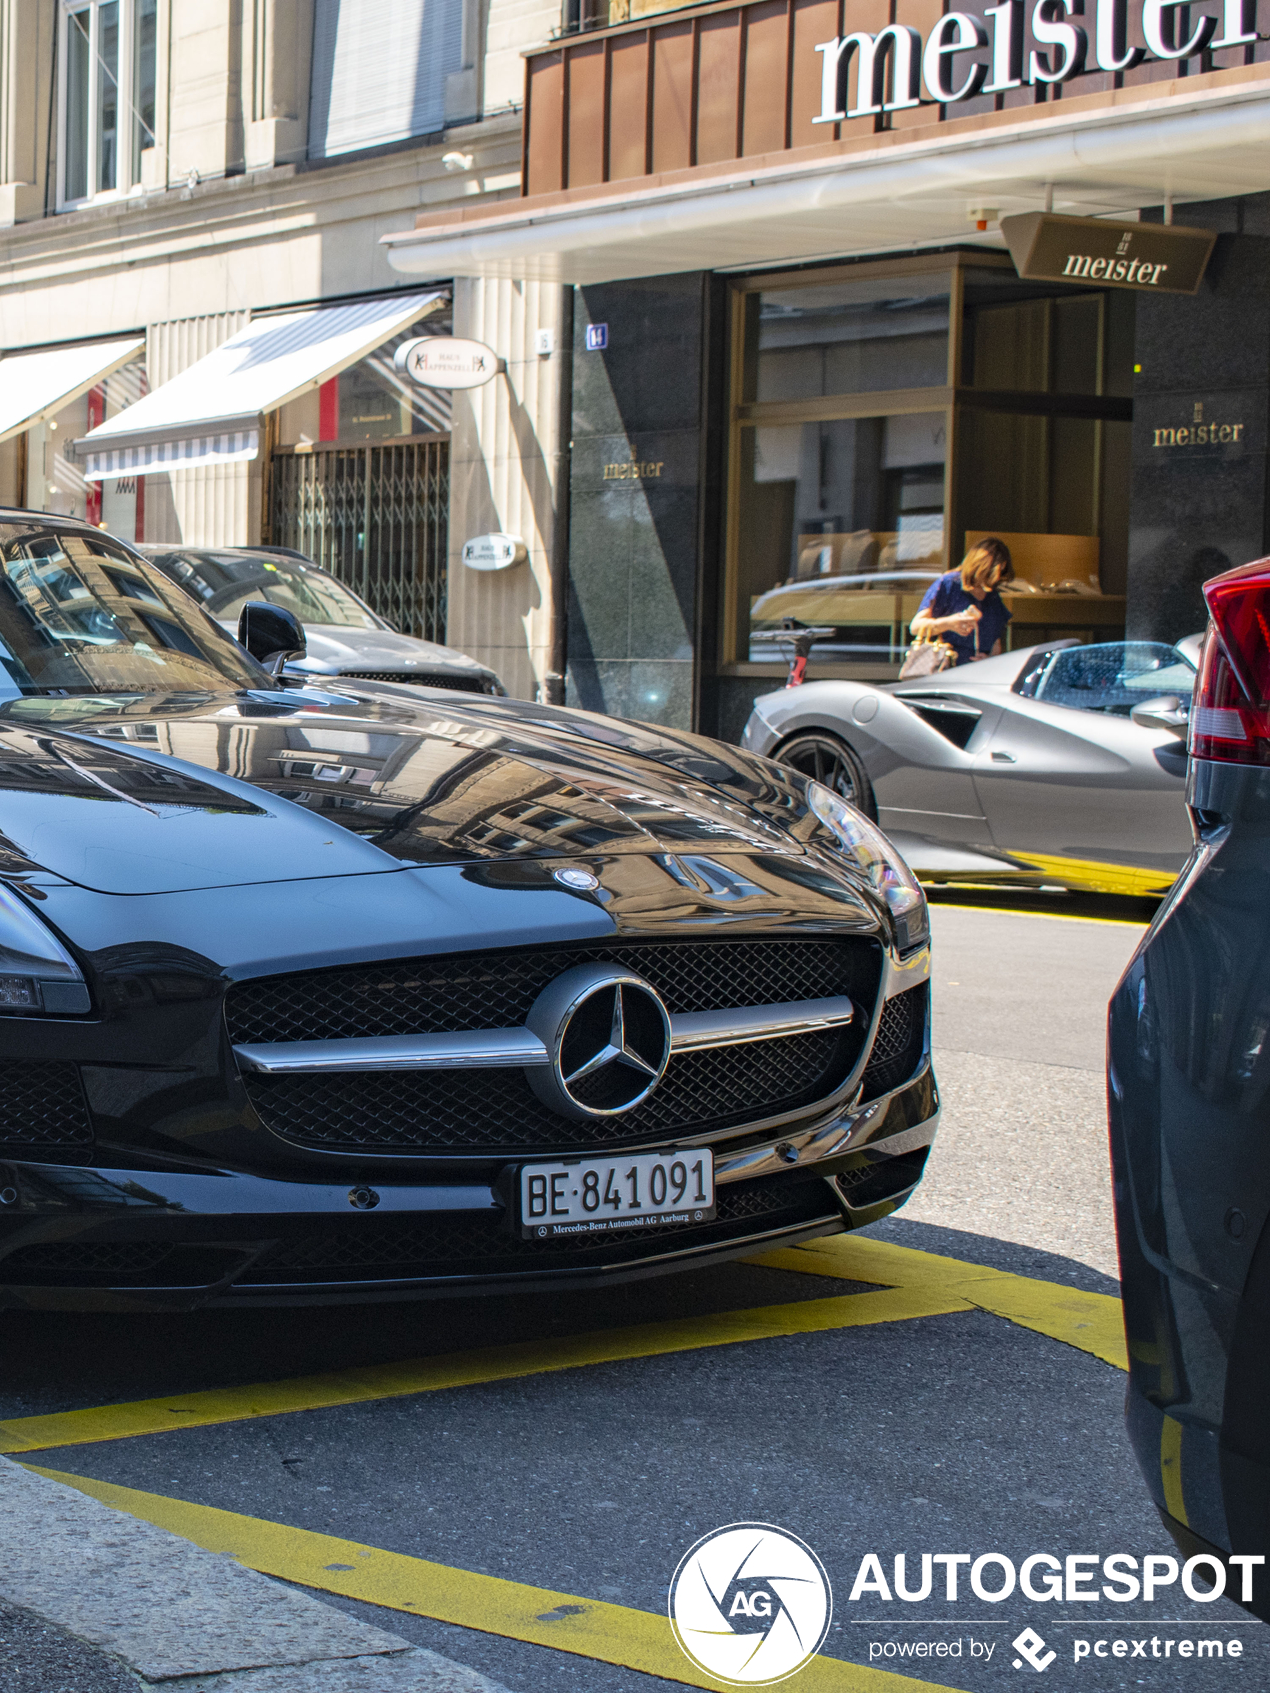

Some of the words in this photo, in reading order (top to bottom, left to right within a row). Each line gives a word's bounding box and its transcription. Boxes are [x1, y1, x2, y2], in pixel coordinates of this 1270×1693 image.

[1062, 255, 1168, 285] meister
[1152, 422, 1244, 447] meister
[603, 461, 664, 480] meister
[553, 1222, 607, 1234] Mercedes-Benz
[608, 1217, 644, 1229] Automobil
[644, 1216, 657, 1225] AG
[660, 1213, 689, 1224] Aarburg
